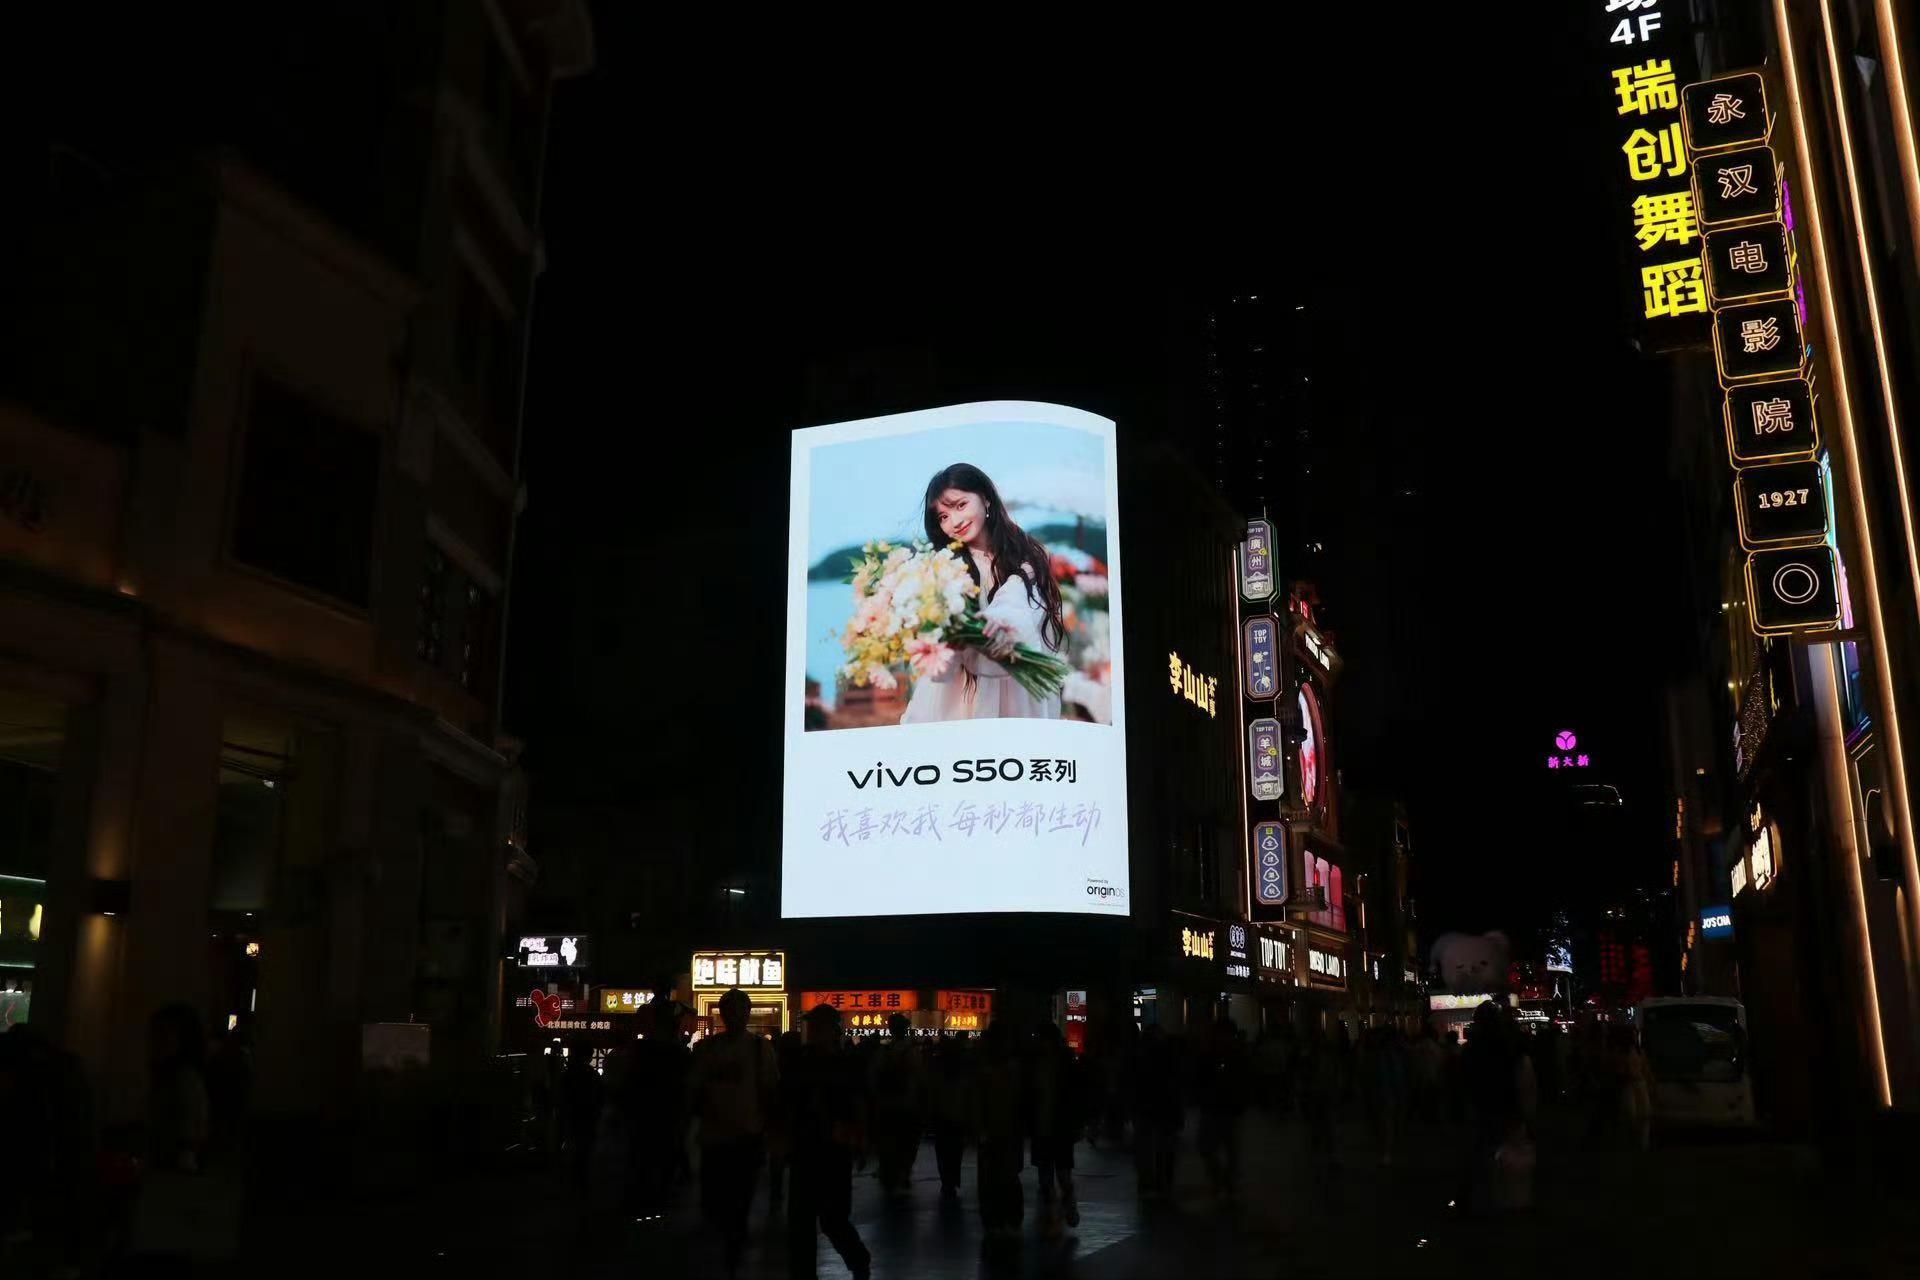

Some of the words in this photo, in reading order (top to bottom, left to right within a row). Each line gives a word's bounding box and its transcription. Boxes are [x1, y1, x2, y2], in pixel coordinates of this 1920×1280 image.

[1610, 12, 1661, 45] 4F
[1611, 58, 1708, 319] 瑞创舞蹈
[1707, 93, 1795, 436] 永汉电影院
[1758, 488, 1809, 509] 1927
[1253, 629, 1267, 637] TOP
[1253, 636, 1267, 644] TOY
[847, 761, 941, 790] vivo
[820, 804, 943, 847] 我喜欢我
[948, 801, 1101, 847] 每秒都生动
[1260, 936, 1274, 968] TOP
[1273, 940, 1286, 971] TOY
